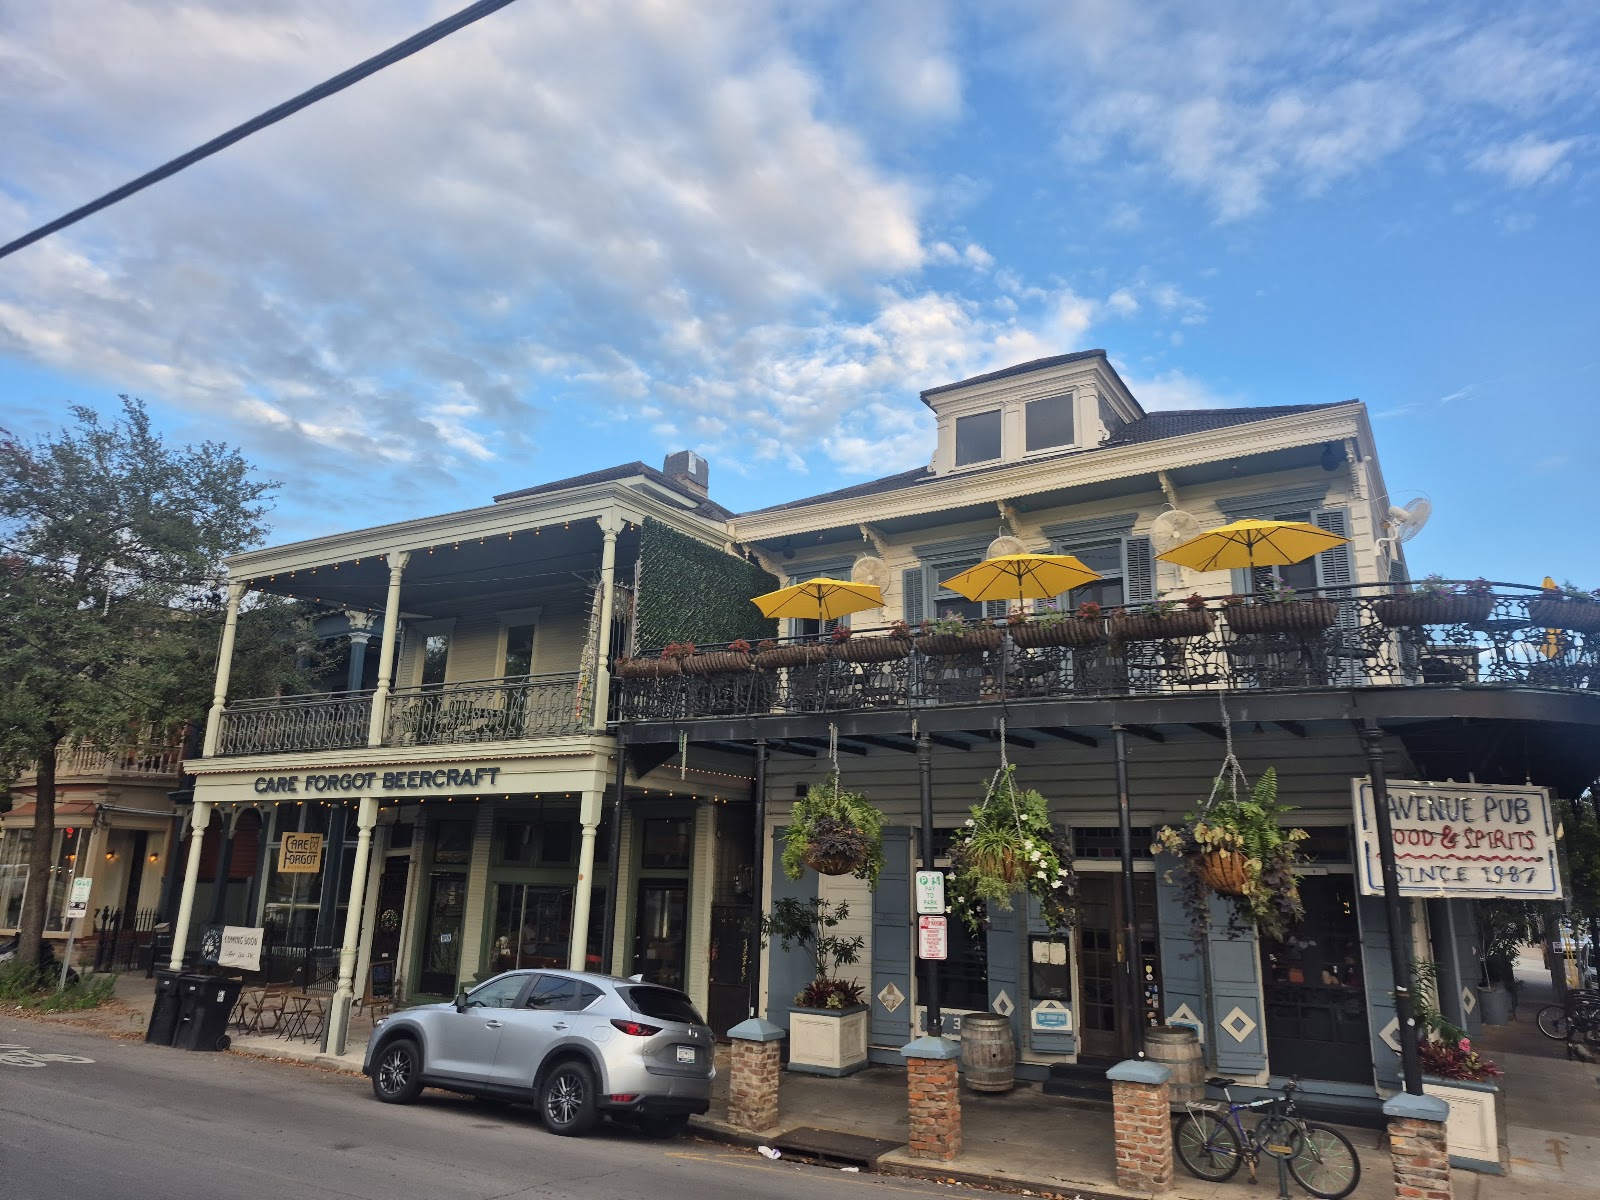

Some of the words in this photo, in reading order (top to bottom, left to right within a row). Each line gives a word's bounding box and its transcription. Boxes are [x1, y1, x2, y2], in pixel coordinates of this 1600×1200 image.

[254, 775, 299, 793] CARE
[305, 772, 376, 792] FORGOT
[382, 767, 501, 789] BEERCRAFT
[1387, 794, 1476, 823] AVENUE
[1484, 795, 1531, 825] PUB
[285, 835, 310, 853] CARE
[1393, 828, 1434, 847] OOD
[1441, 825, 1459, 849] &
[1464, 828, 1536, 851] SPIRITS
[283, 851, 317, 868] FORGOT
[1395, 863, 1469, 883] SINCE
[1481, 867, 1537, 884] 1987
[224, 935, 243, 944] COMING
[244, 936, 258, 946] SOON
